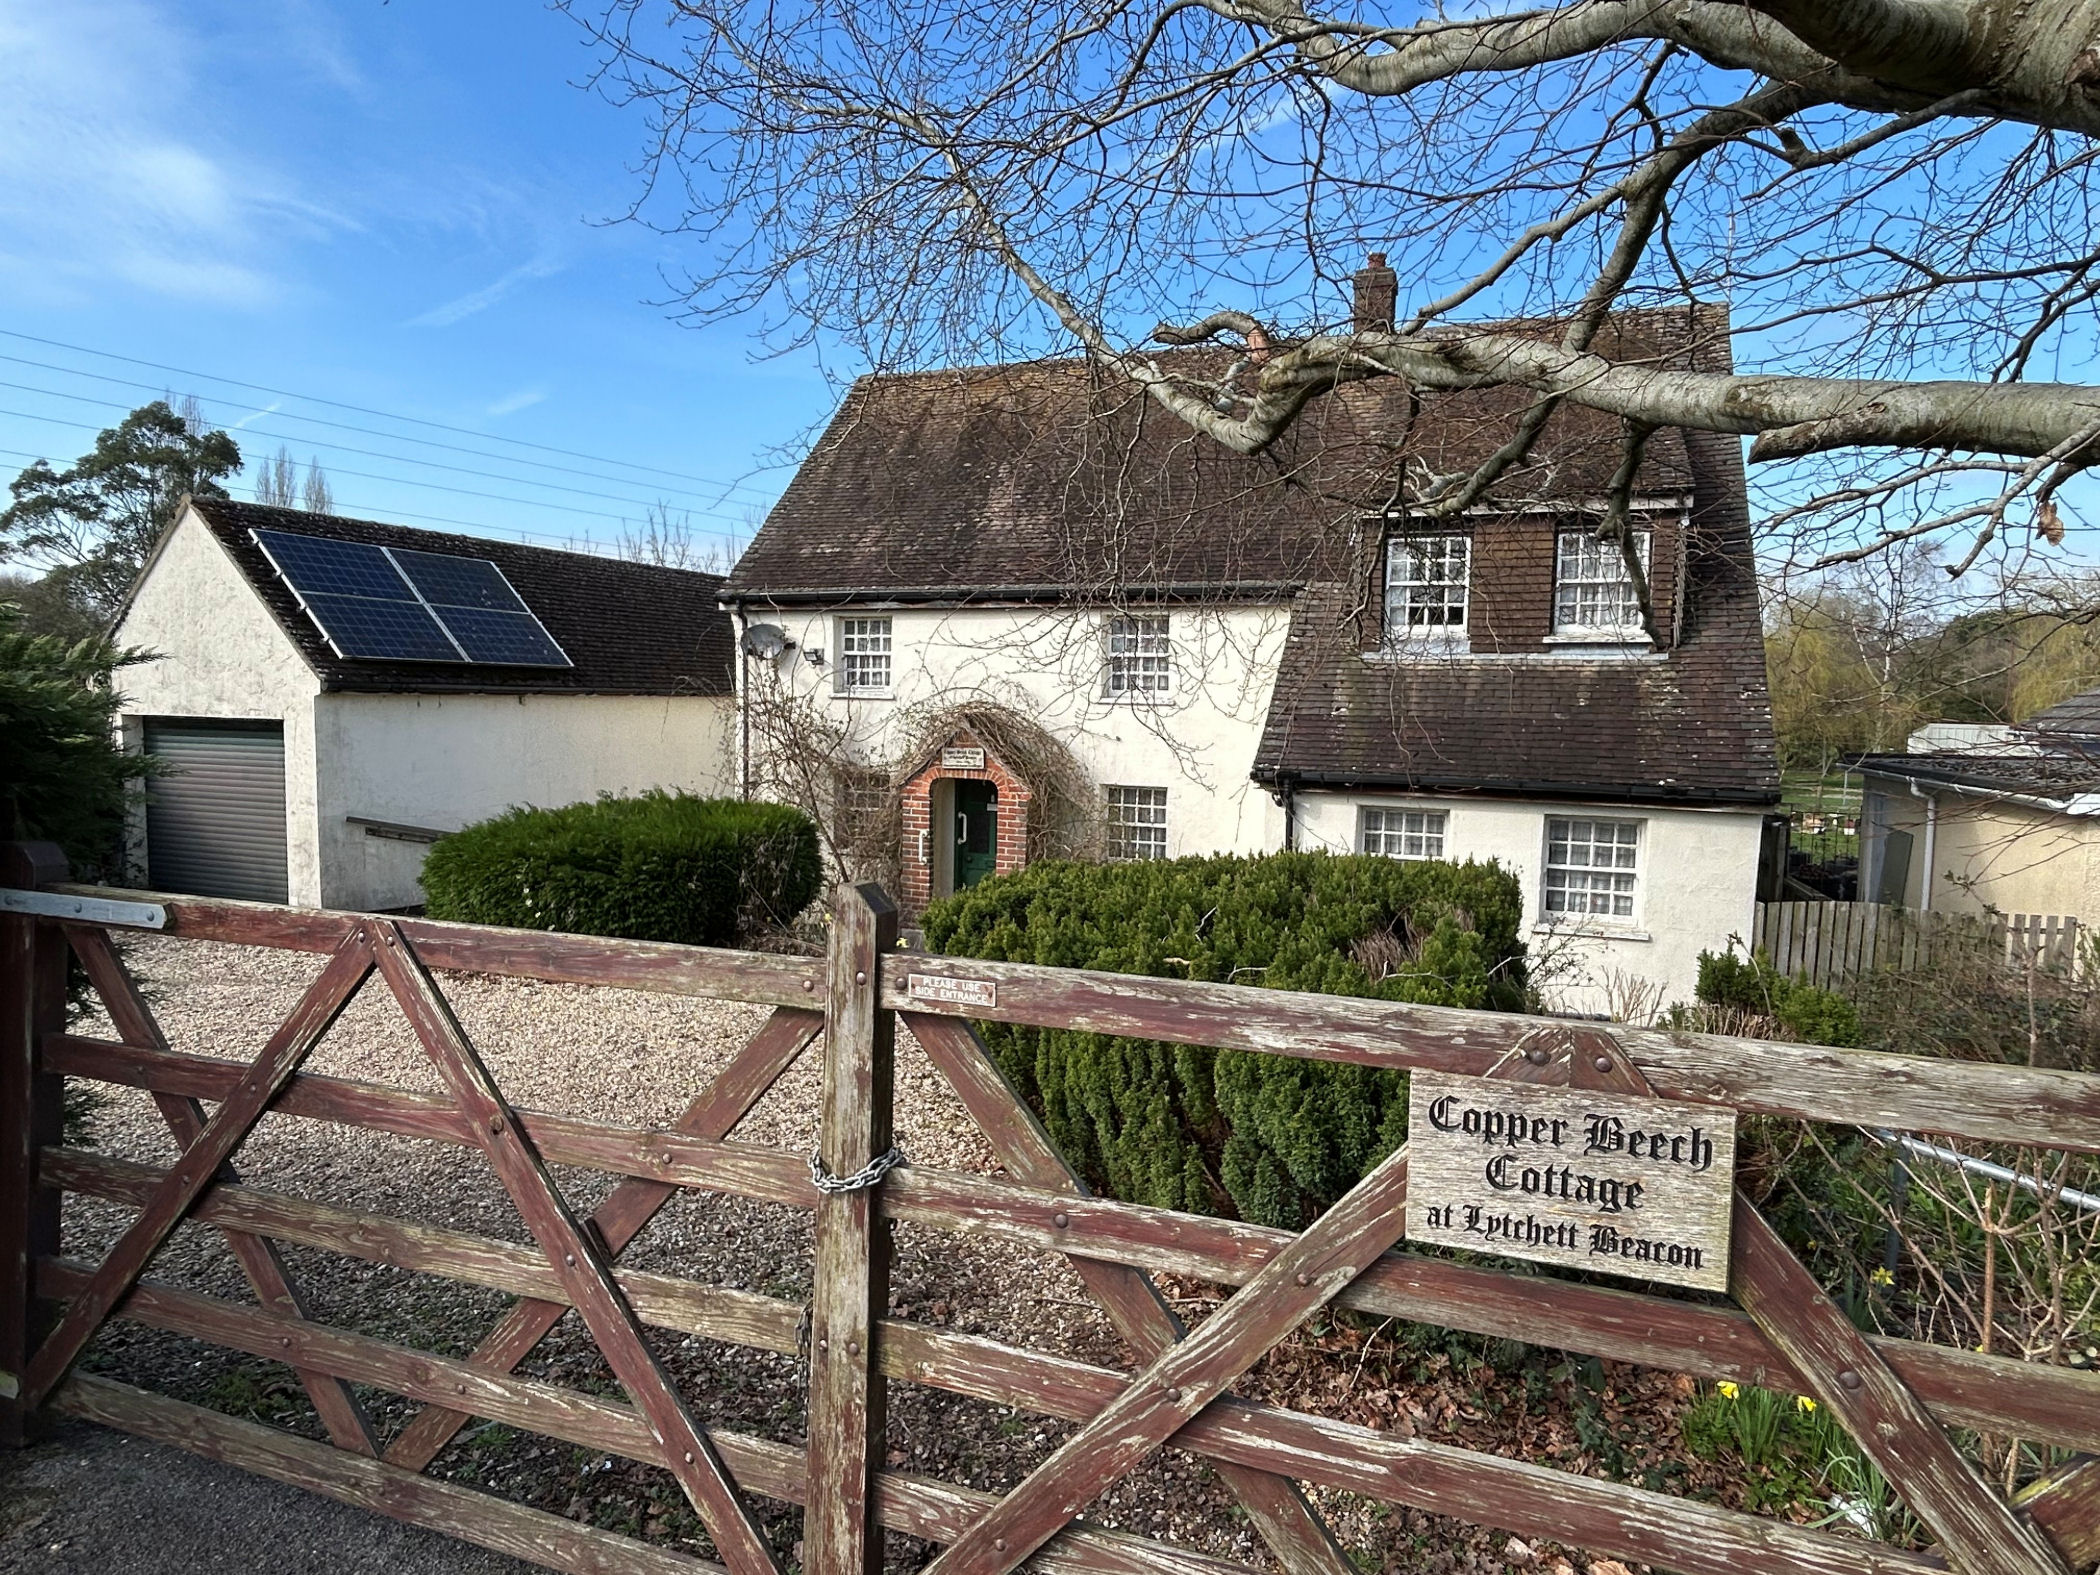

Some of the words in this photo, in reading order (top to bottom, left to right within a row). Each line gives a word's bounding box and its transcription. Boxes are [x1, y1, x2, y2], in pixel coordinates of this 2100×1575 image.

[915, 986, 935, 997] SIDE
[940, 989, 987, 1002] ENTRANCE
[923, 977, 957, 989] PLEASE
[962, 983, 980, 992] USE
[1428, 1095, 1570, 1147] Copper
[1583, 1113, 1713, 1173] Beech
[1485, 1154, 1645, 1214] Cottage
[1426, 1202, 1453, 1229] at
[1462, 1204, 1579, 1250] Lytchett
[1589, 1223, 1704, 1270] Beacon
